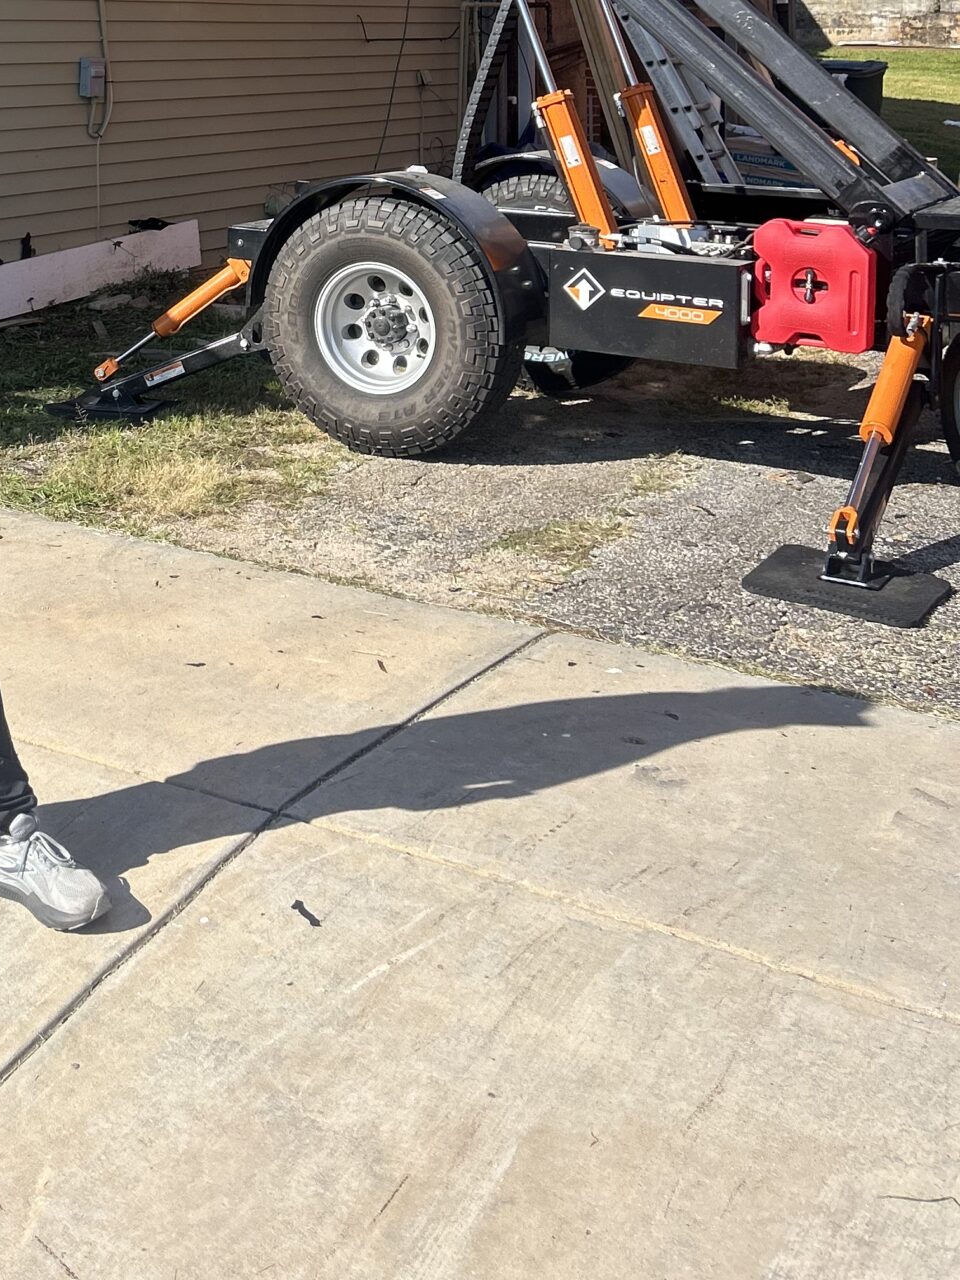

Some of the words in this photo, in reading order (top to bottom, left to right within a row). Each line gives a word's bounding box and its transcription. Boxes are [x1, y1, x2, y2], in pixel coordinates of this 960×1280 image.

[736, 153, 786, 168] LANDMARK
[610, 287, 724, 308] EQUIPTER
[655, 306, 704, 321] 4000
